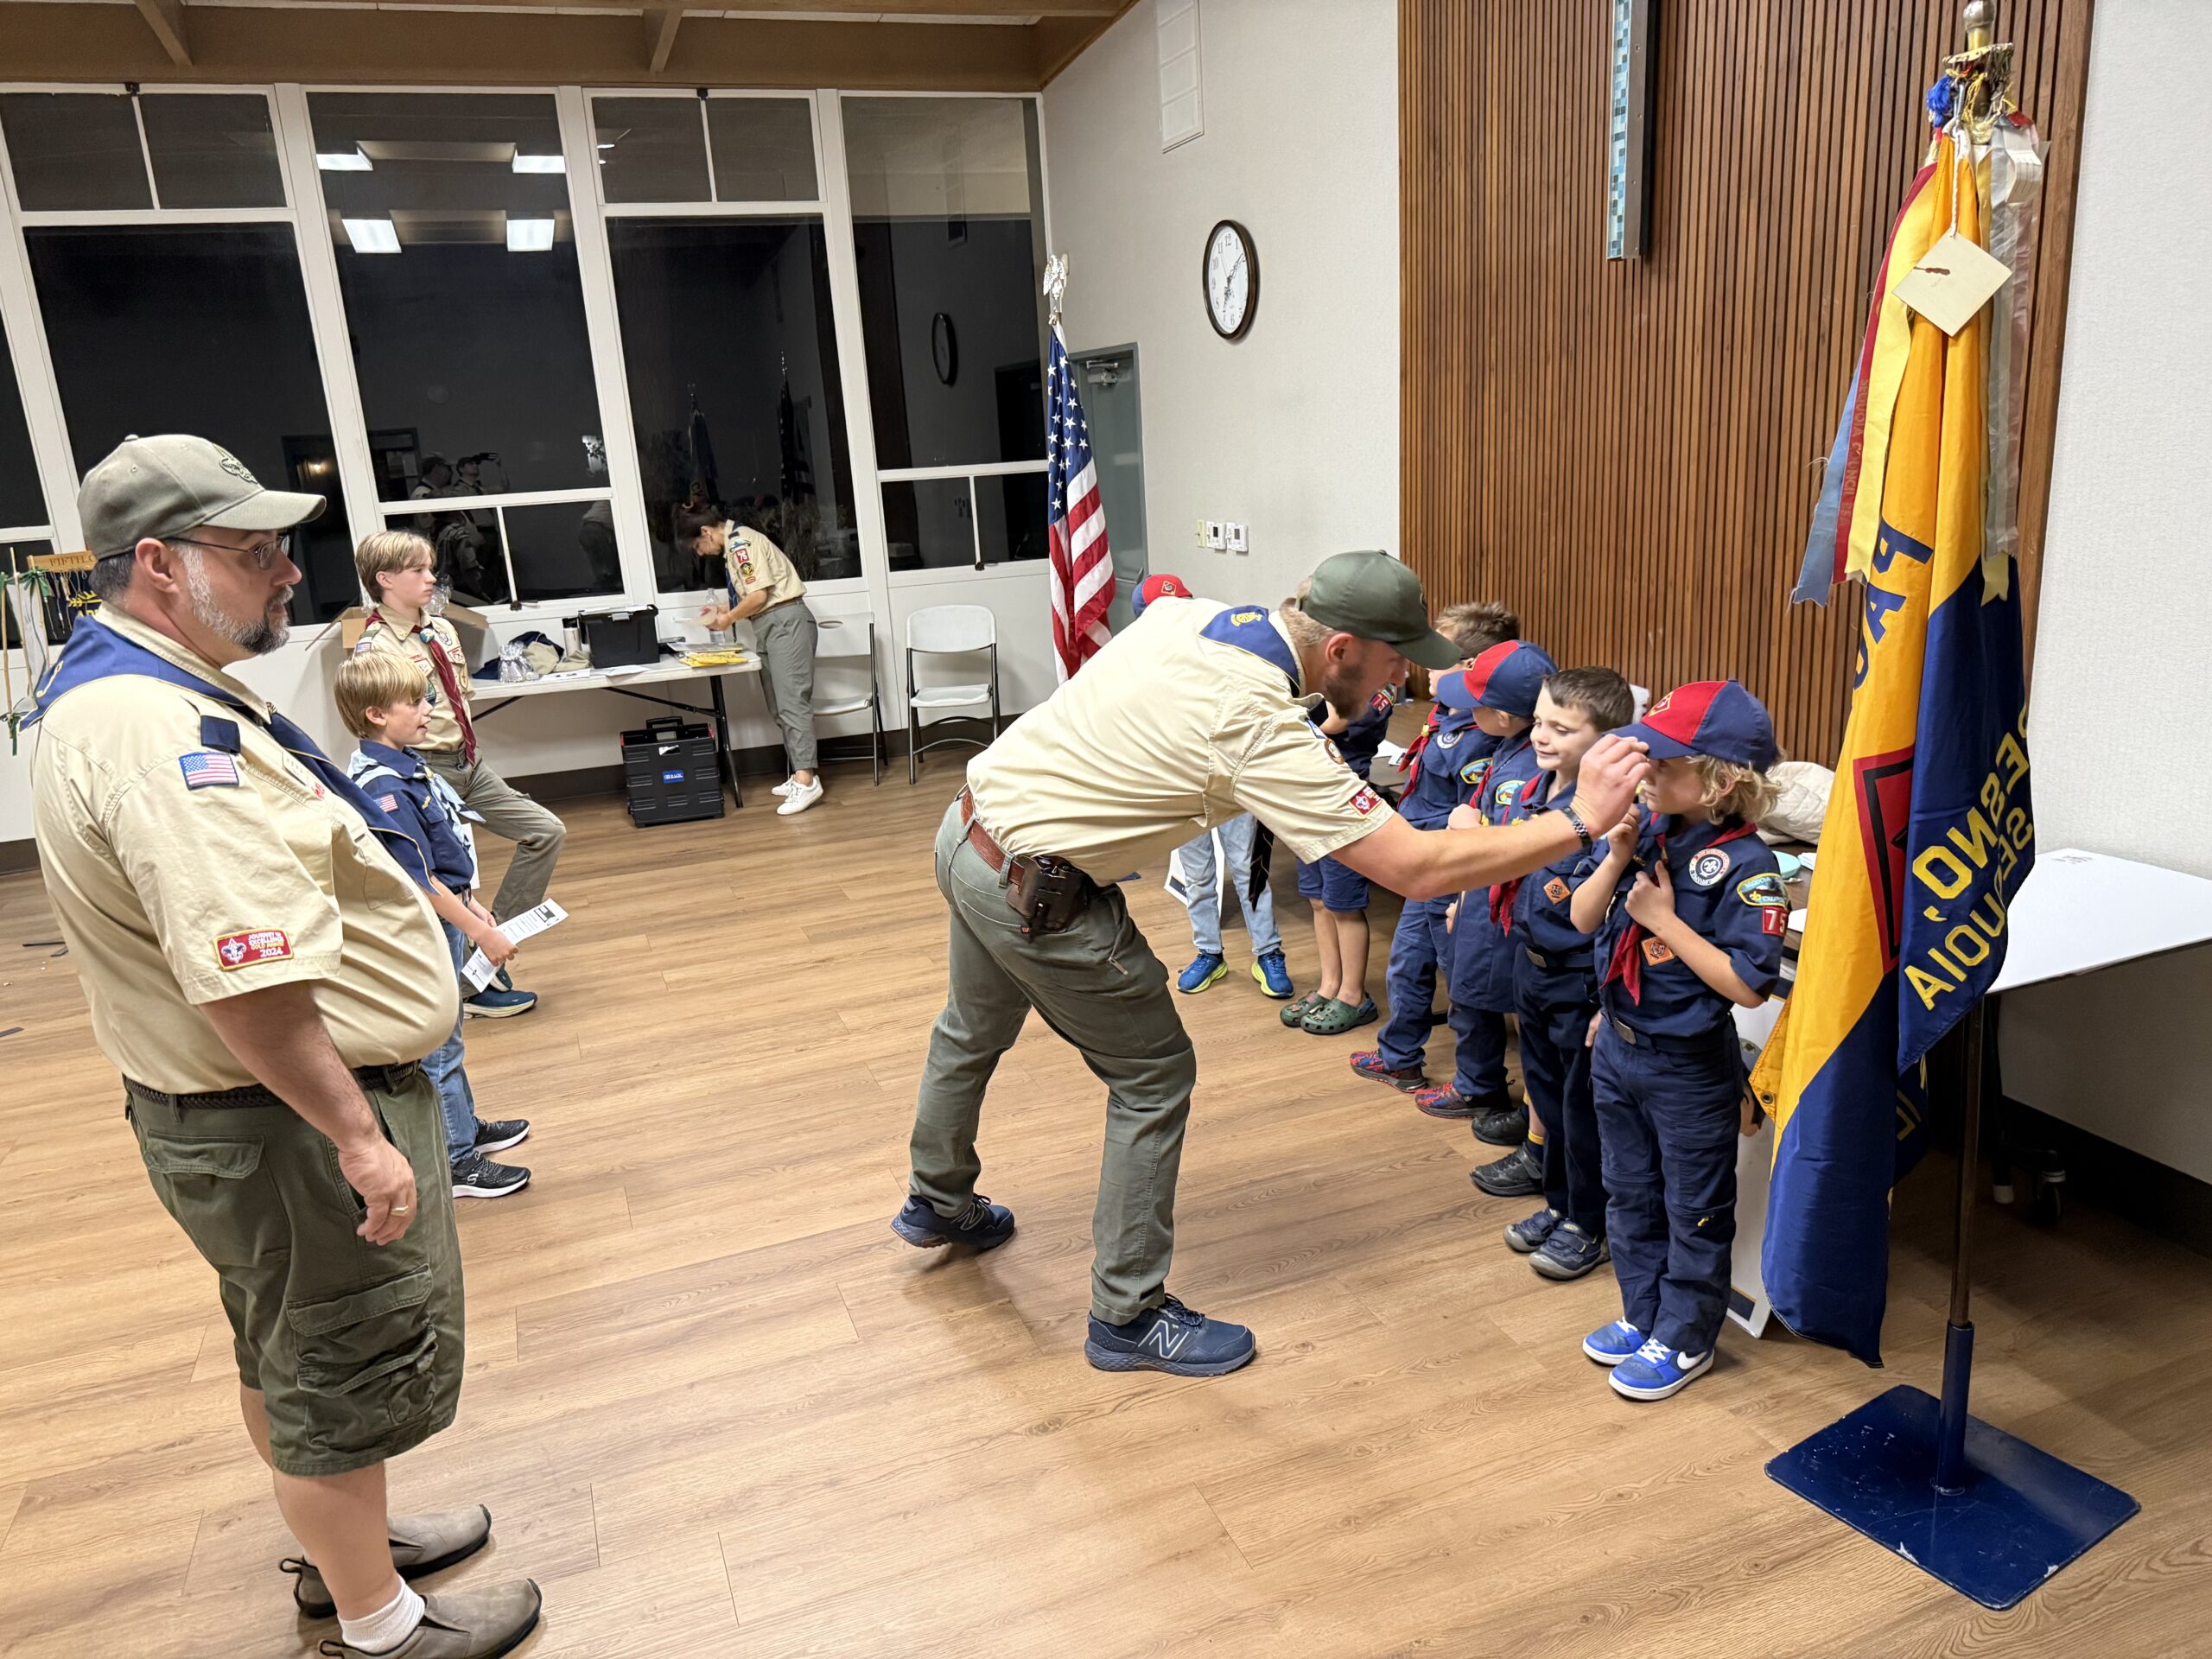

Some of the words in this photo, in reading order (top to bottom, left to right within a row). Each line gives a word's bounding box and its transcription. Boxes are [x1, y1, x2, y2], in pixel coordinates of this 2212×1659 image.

[1224, 232, 1231, 247] 12
[1217, 241, 1224, 254] 11
[1213, 257, 1219, 270] 10
[1211, 277, 1216, 290] 9
[1230, 314, 1235, 326] 6
[1852, 379, 1869, 437] SEQUOIA
[1765, 909, 1786, 933] 75
[259, 947, 283, 957] 2024
